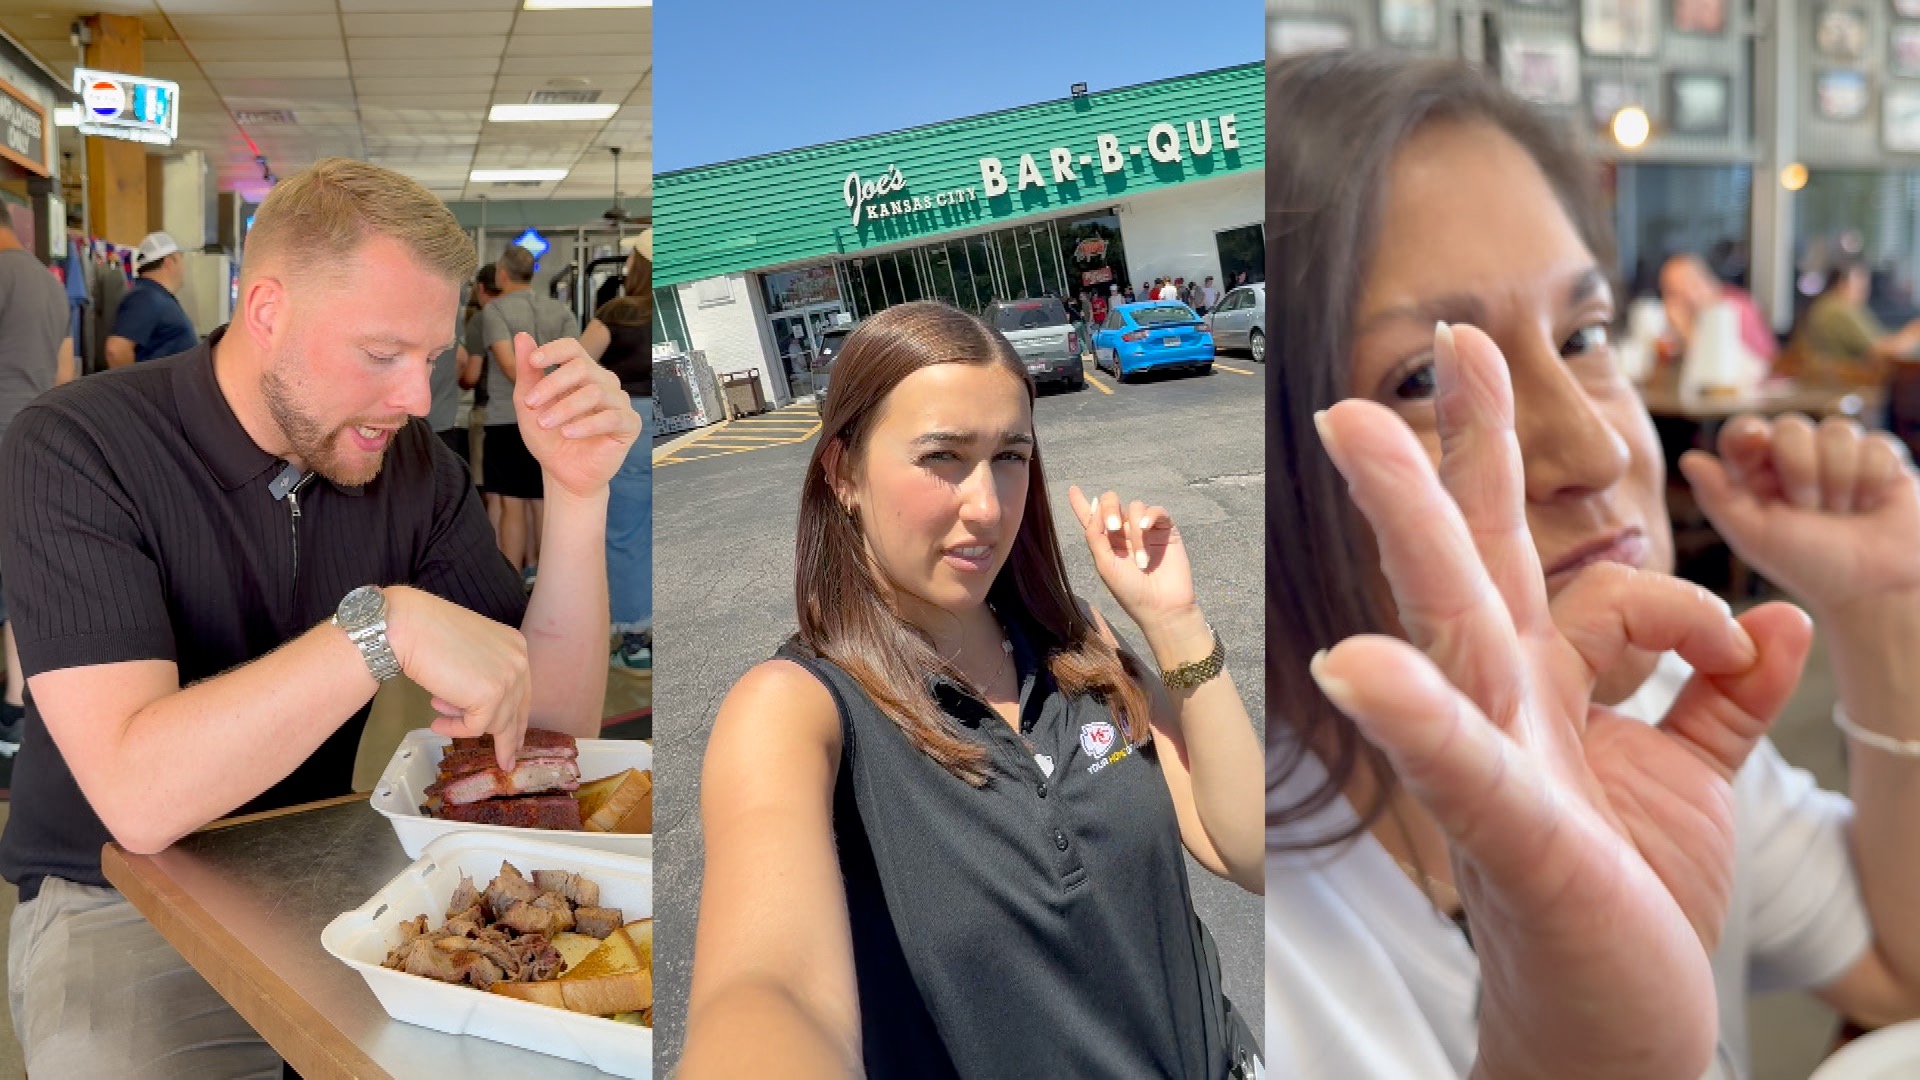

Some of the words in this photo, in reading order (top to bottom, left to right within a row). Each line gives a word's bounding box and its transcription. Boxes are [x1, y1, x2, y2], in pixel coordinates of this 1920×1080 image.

[7, 126, 30, 154] ONLY
[979, 113, 1240, 197] BAR-B-QUE
[843, 164, 907, 226] Joe's
[866, 196, 932, 219] KANSAS
[936, 187, 977, 206] CITY
[1087, 757, 1109, 774] YOUR
